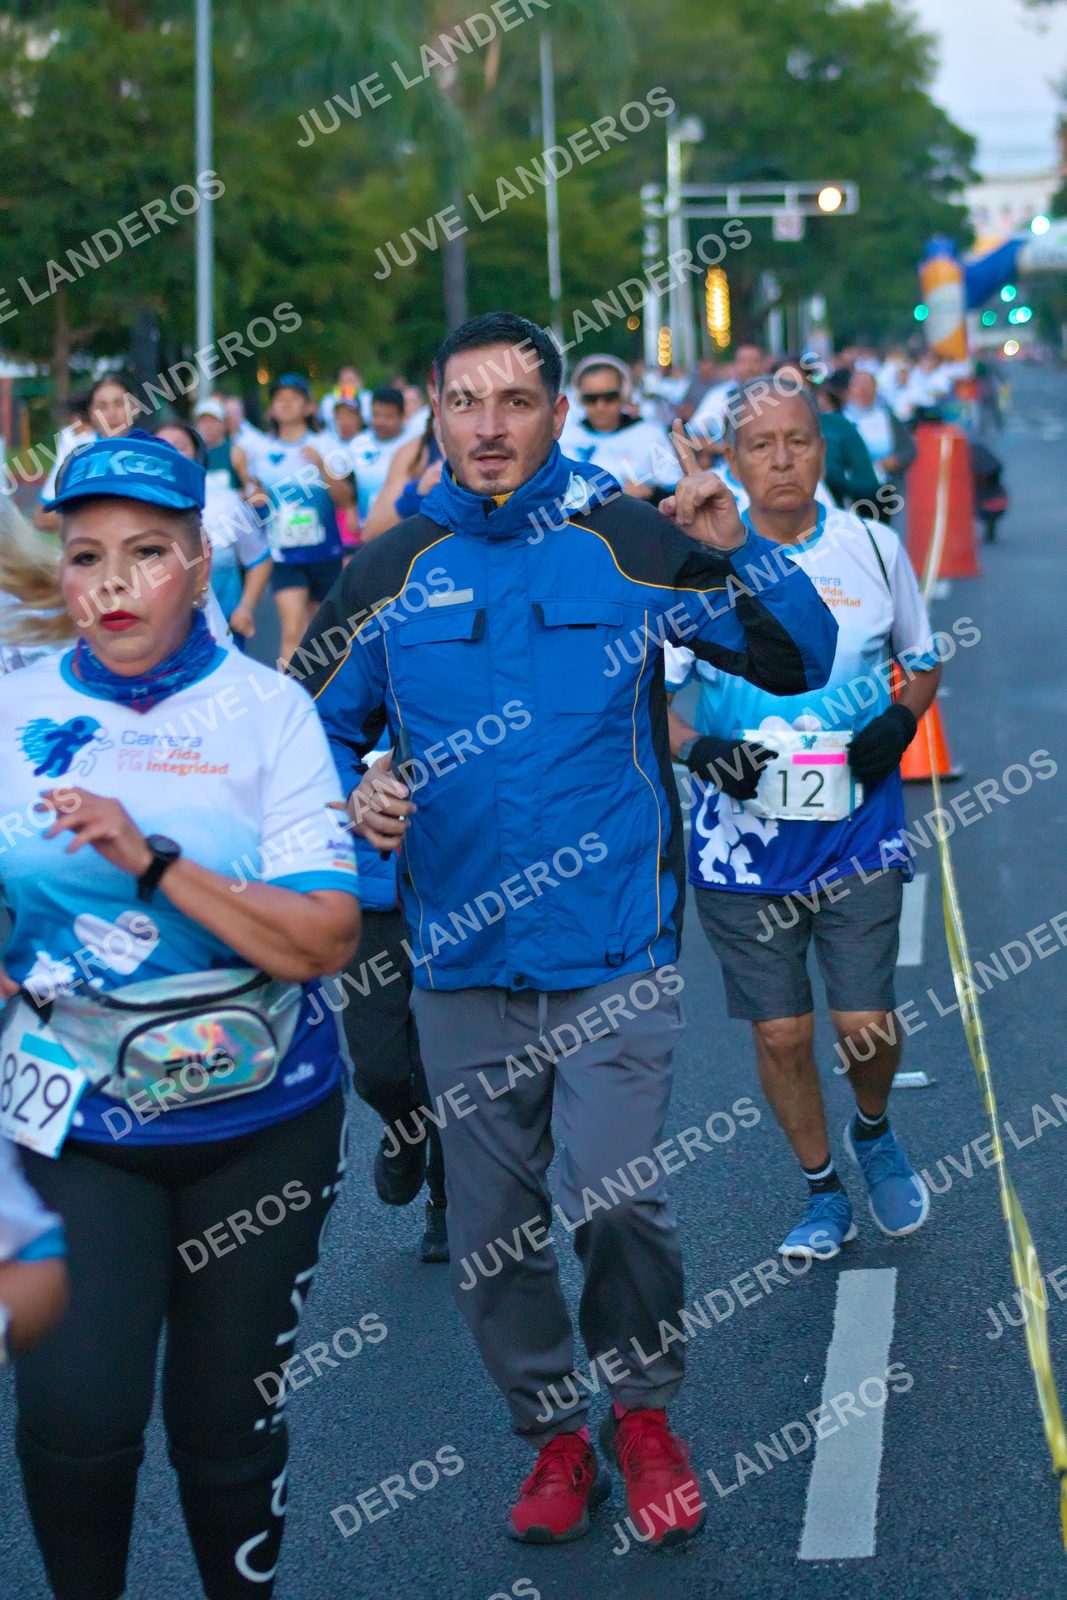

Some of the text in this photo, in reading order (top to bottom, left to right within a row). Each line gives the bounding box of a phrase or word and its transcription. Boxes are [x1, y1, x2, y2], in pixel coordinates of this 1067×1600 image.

[167, 748, 201, 760] Vida
[777, 770, 824, 807] 12
[1, 1053, 71, 1130] 829
